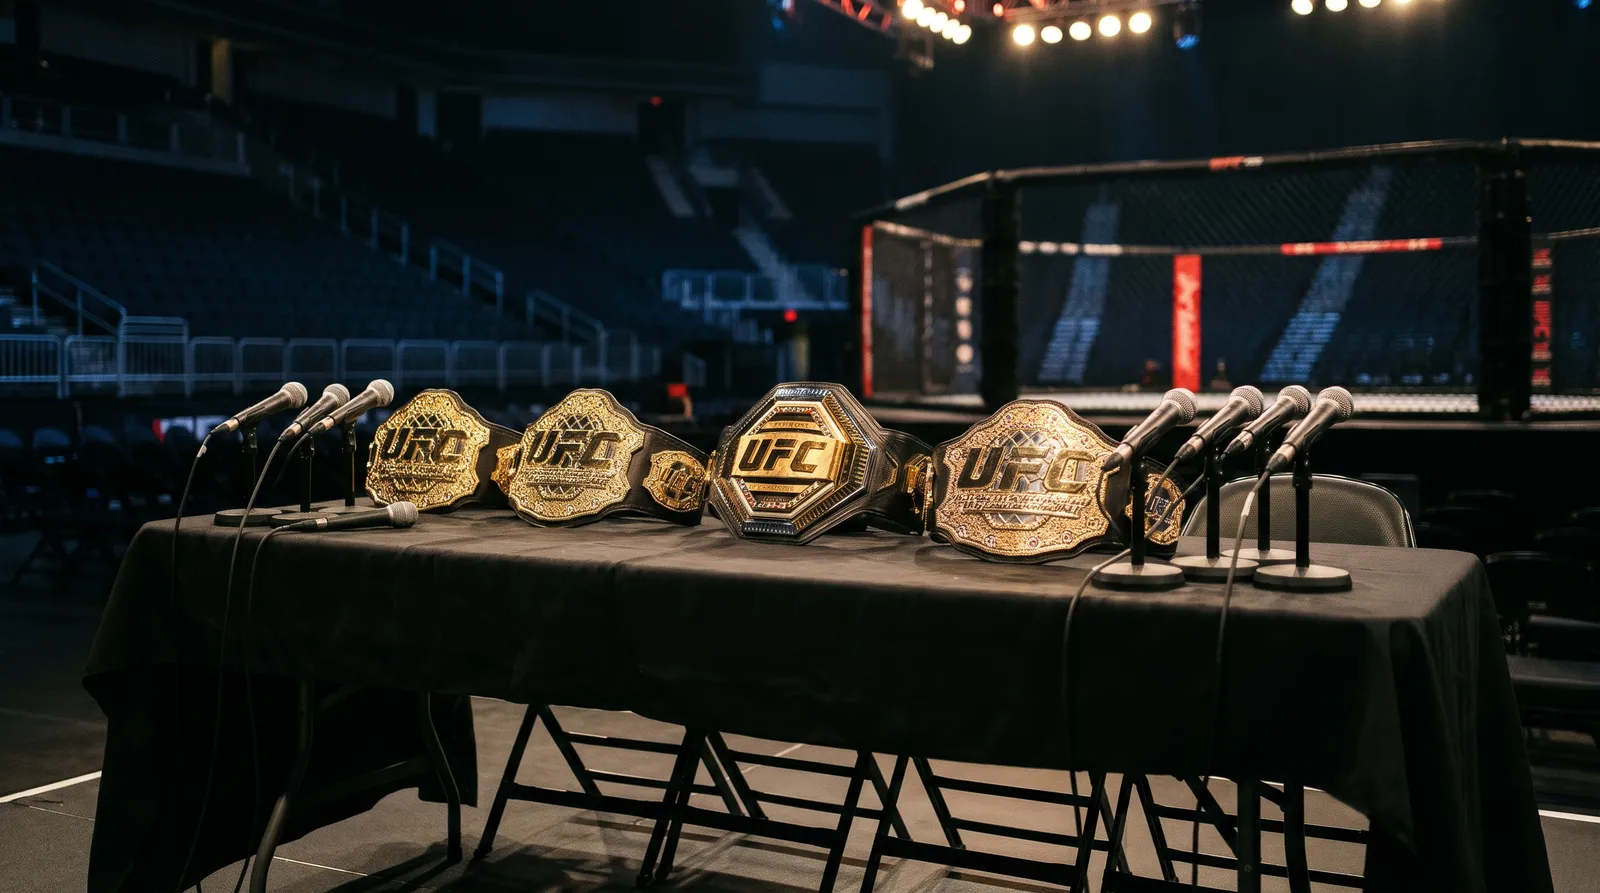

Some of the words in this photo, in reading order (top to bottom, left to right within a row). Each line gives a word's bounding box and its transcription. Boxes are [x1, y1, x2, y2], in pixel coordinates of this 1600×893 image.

[527, 429, 620, 469] UFC
[738, 438, 829, 473] UFC
[957, 446, 1097, 493] UFC
